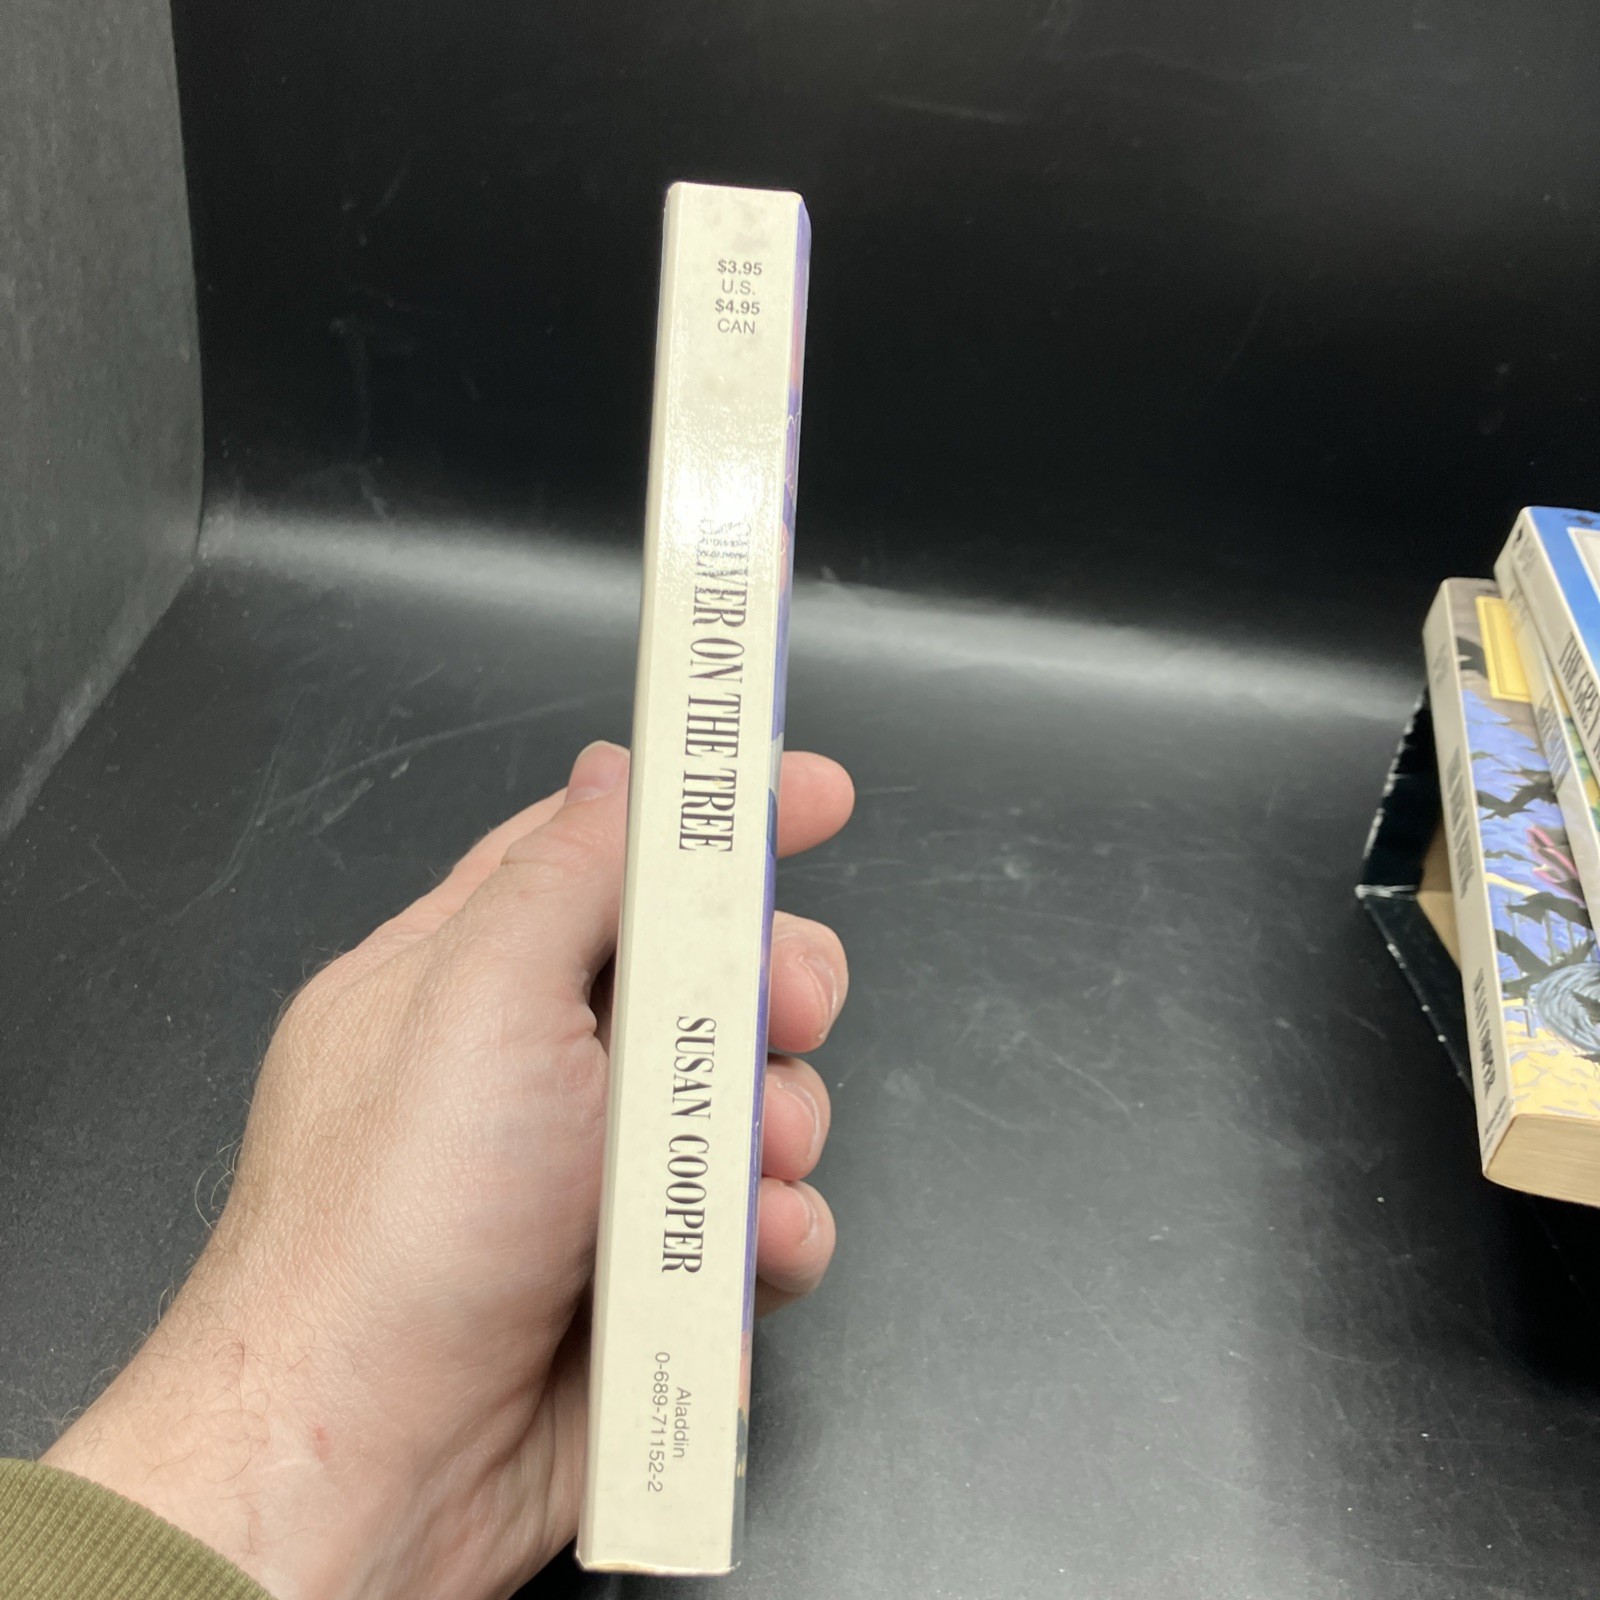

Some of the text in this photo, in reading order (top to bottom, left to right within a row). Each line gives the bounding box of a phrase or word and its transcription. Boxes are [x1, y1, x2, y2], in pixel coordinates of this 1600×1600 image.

[717, 258, 762, 276] $3.95
[721, 279, 756, 295] U.S.
[715, 298, 760, 315] $4.95
[717, 318, 756, 334] CAN
[689, 637, 745, 684] ON
[685, 692, 741, 758] THE
[679, 768, 737, 852] TREE
[662, 1016, 716, 1273] SUSAN COOPER
[647, 1351, 670, 1492] 0-689-71152-2
[672, 1386, 692, 1458] Aladdin
